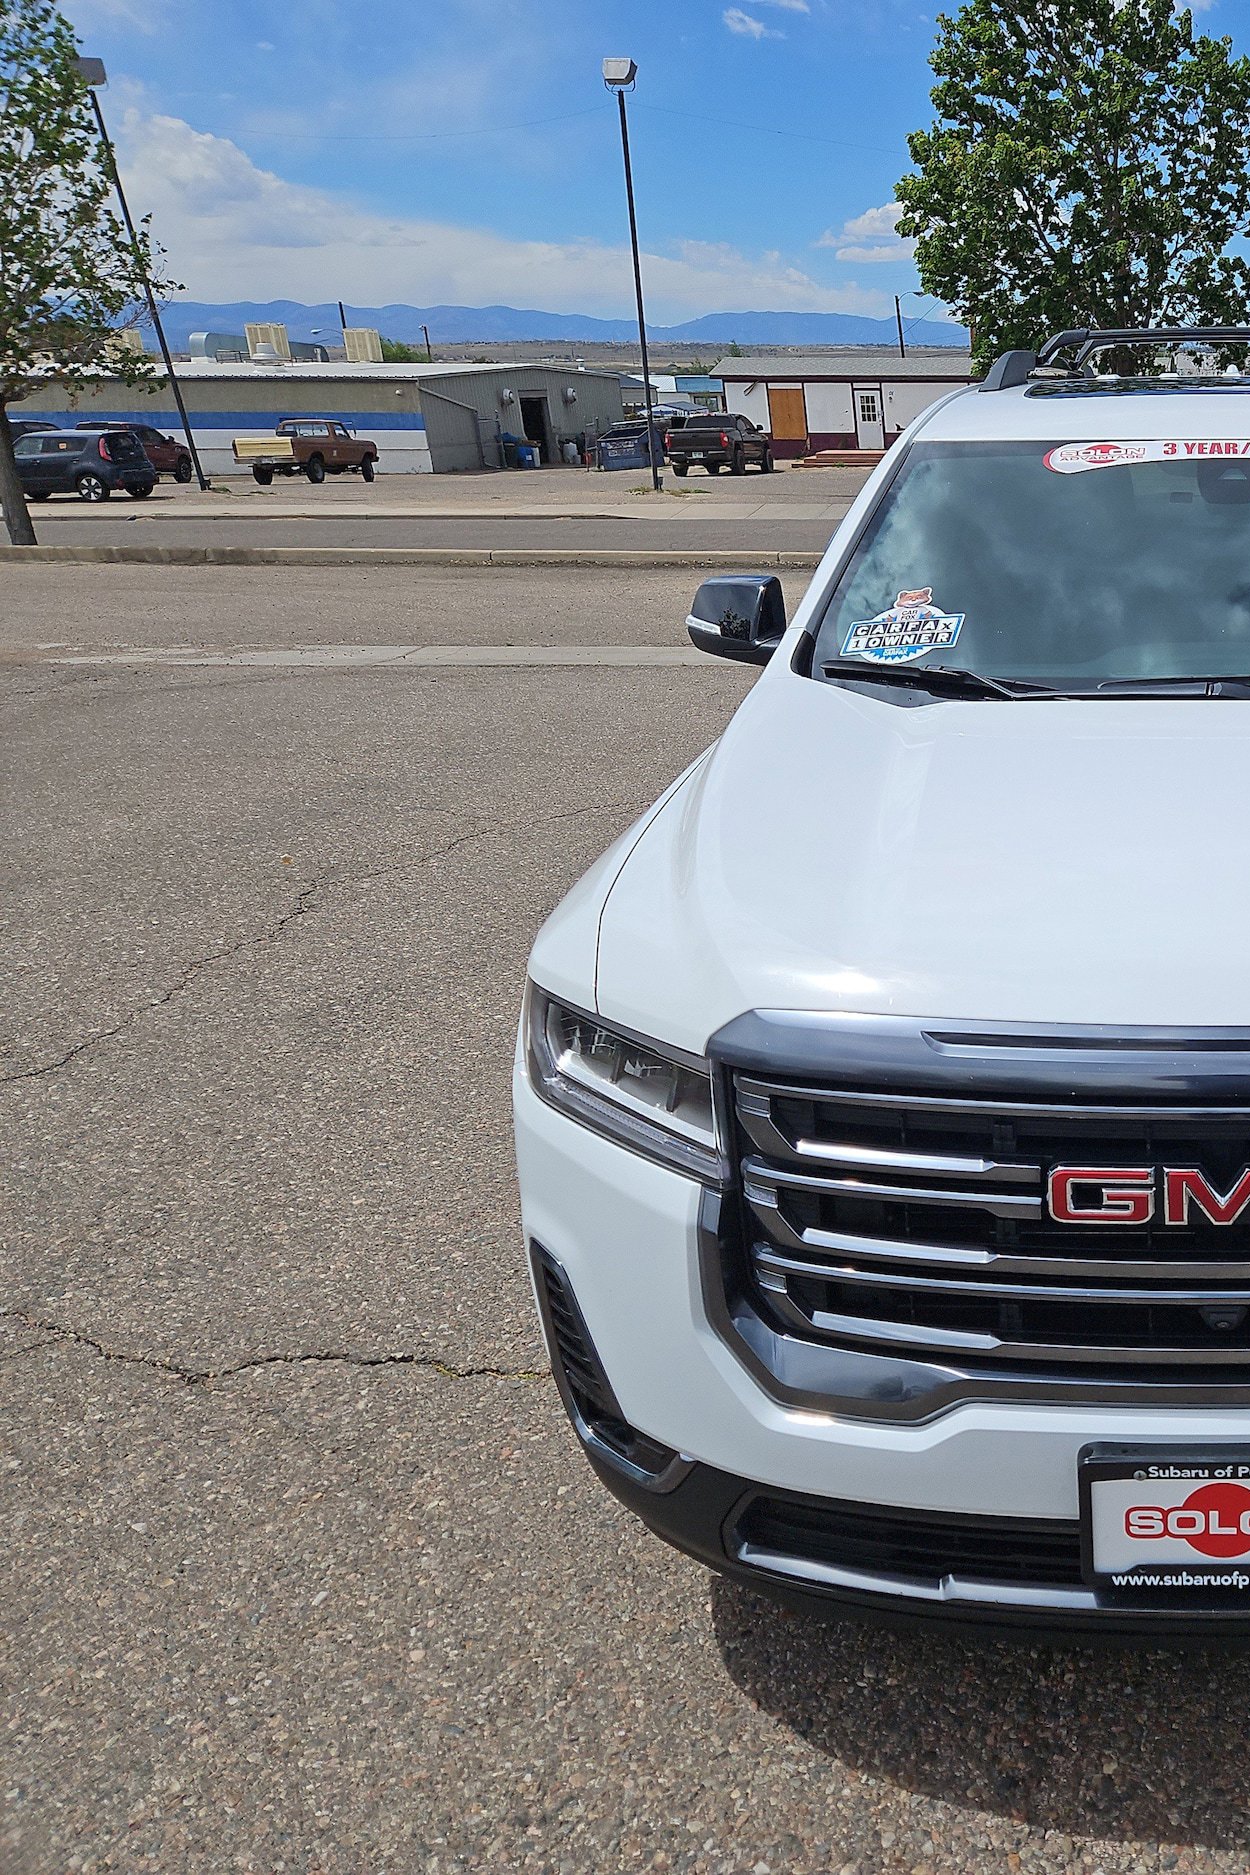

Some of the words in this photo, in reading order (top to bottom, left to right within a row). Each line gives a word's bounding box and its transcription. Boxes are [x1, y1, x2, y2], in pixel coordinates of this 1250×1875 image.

[1060, 447, 1146, 457] SOLON
[1163, 442, 1178, 455] 3
[854, 619, 954, 637] CARFAX
[866, 632, 952, 648] OWNER
[1148, 1465, 1210, 1479] Subaru
[1214, 1465, 1234, 1479] of
